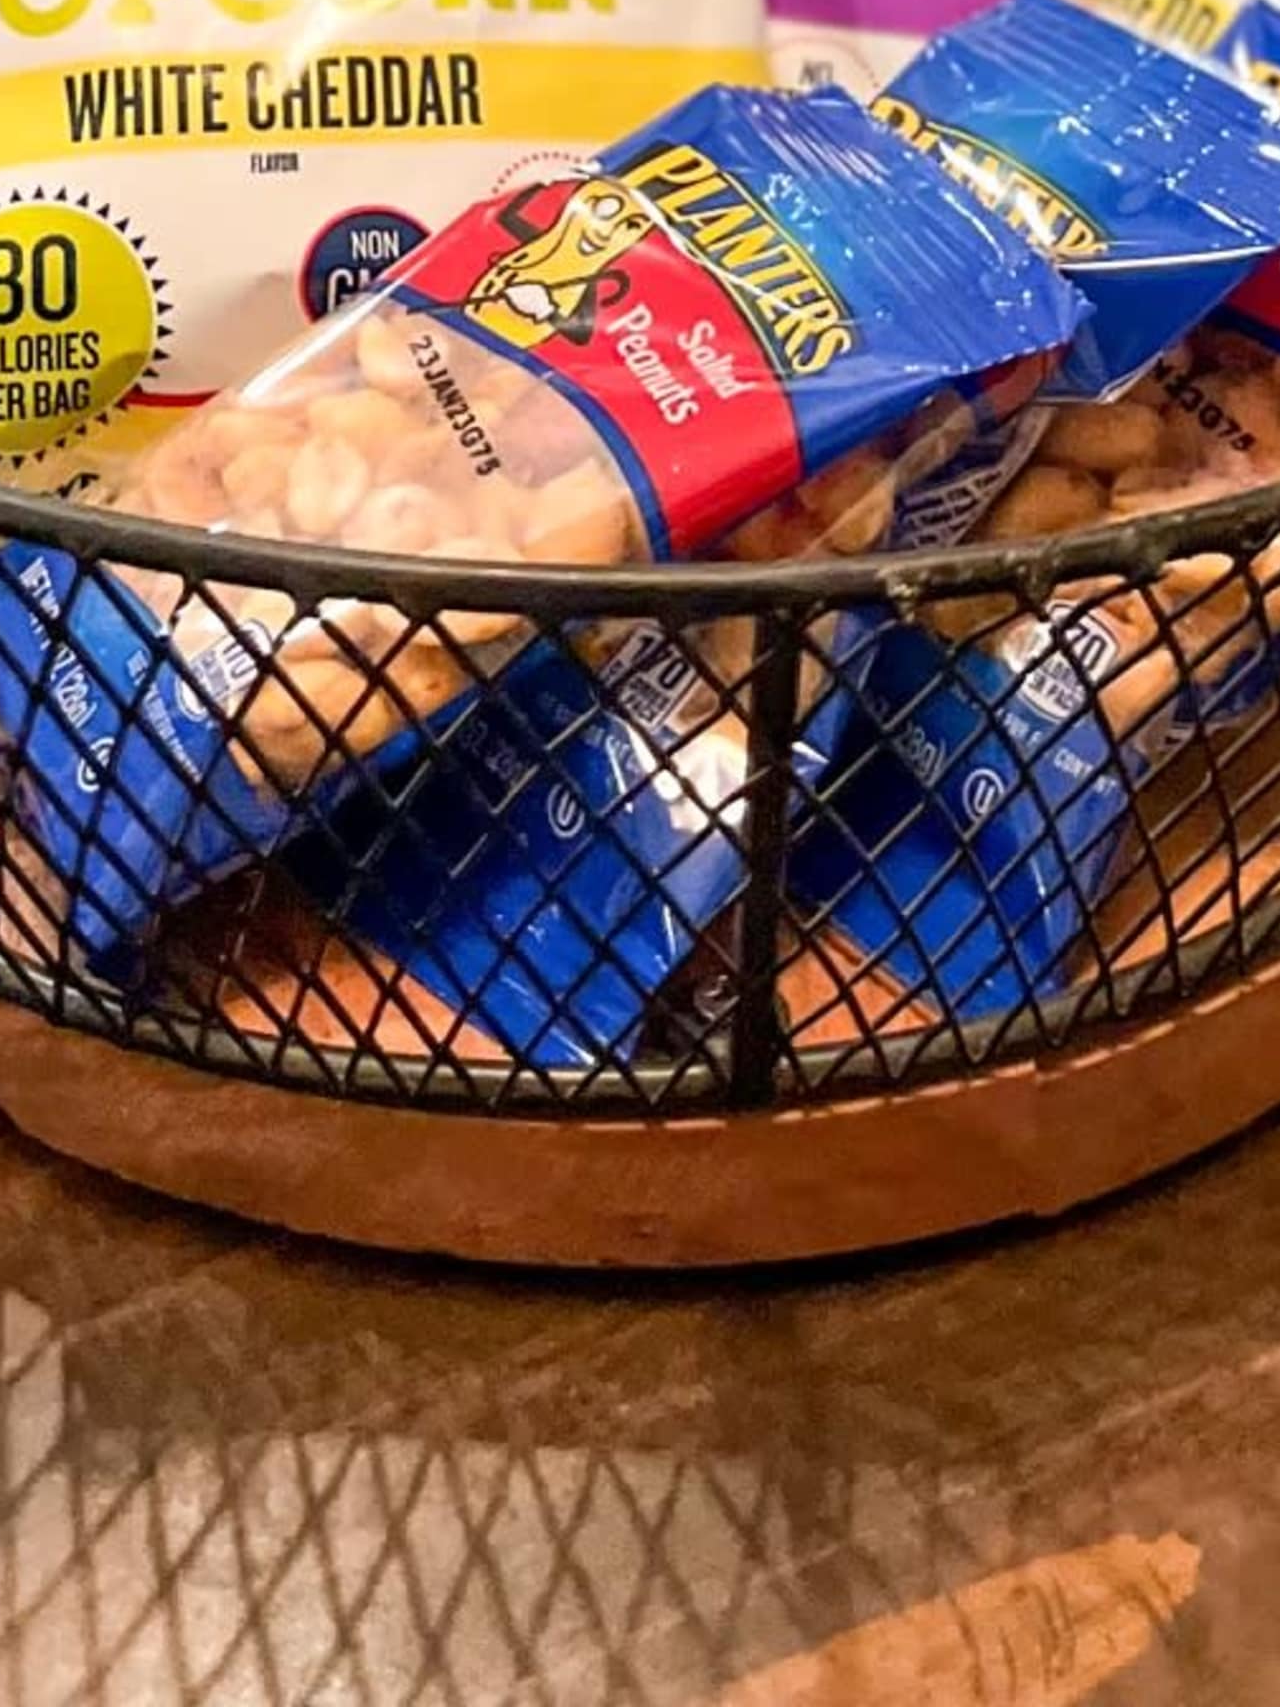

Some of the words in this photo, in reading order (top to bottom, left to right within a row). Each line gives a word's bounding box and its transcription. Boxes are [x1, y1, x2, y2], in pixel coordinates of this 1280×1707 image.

[63, 63, 229, 143] WHITE
[245, 53, 485, 131] CHEDDAR
[250, 153, 300, 174] FLAVOR
[350, 230, 401, 260] NON
[620, 144, 852, 375] PLANTERS
[606, 303, 700, 425] Peanuts
[34, 378, 91, 418] BAG
